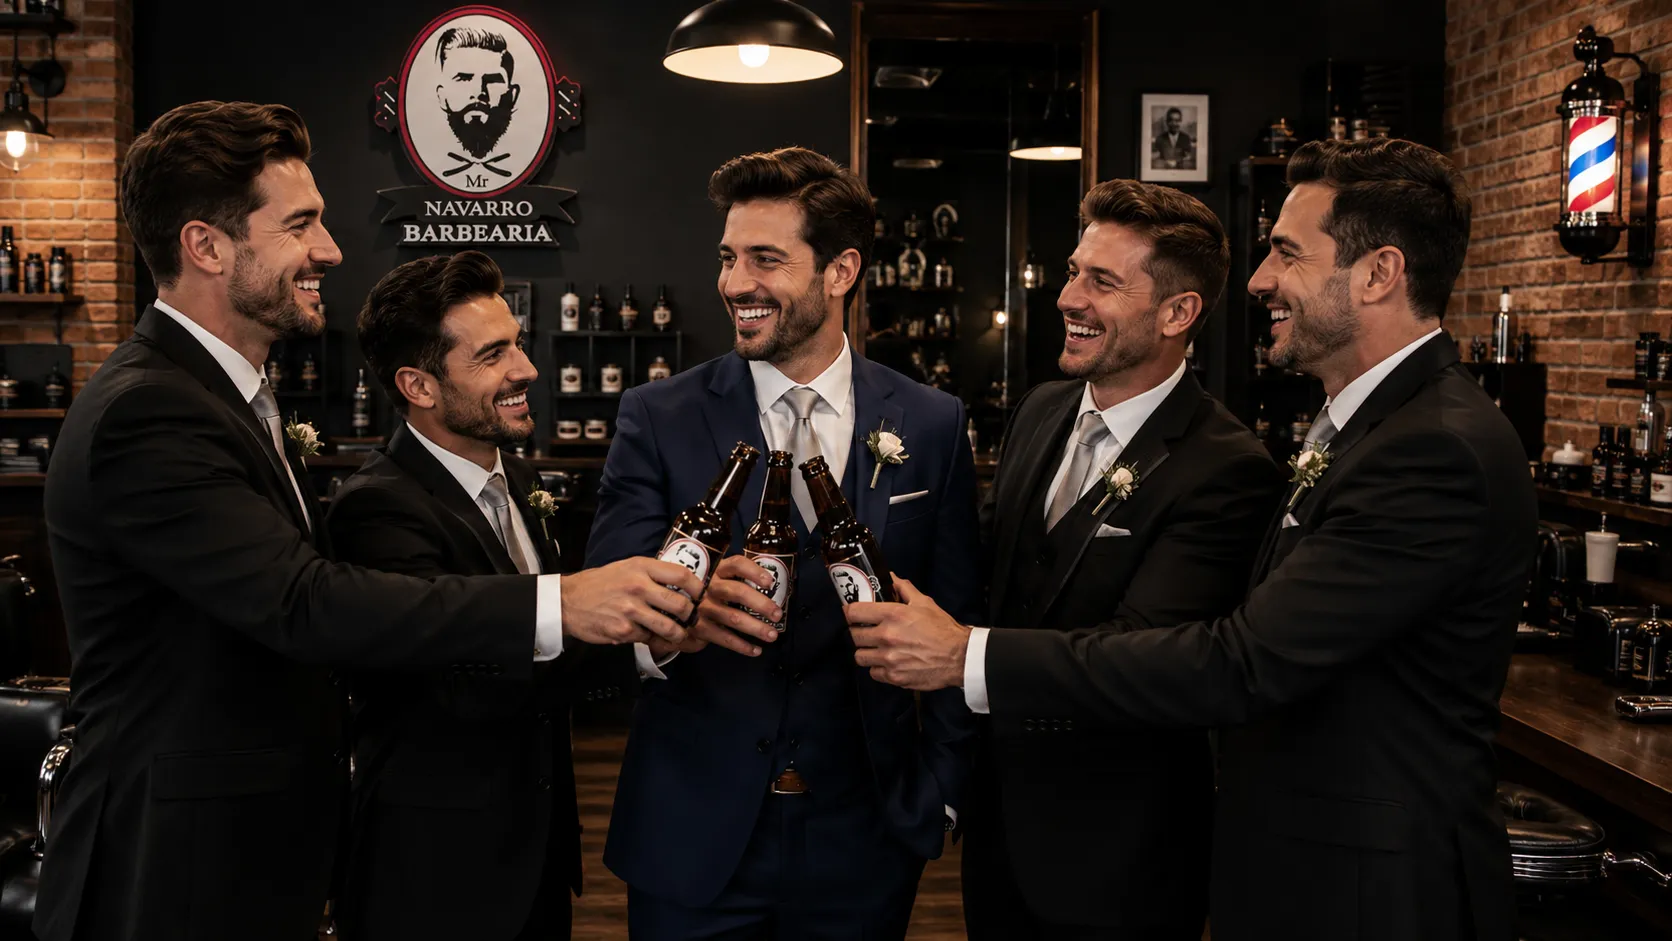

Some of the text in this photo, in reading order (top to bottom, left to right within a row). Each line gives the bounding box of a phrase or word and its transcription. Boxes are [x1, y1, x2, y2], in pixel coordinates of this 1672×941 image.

[465, 174, 489, 188] Mr
[424, 200, 533, 217] NAVARRO
[403, 224, 552, 242] BARBEARIA
